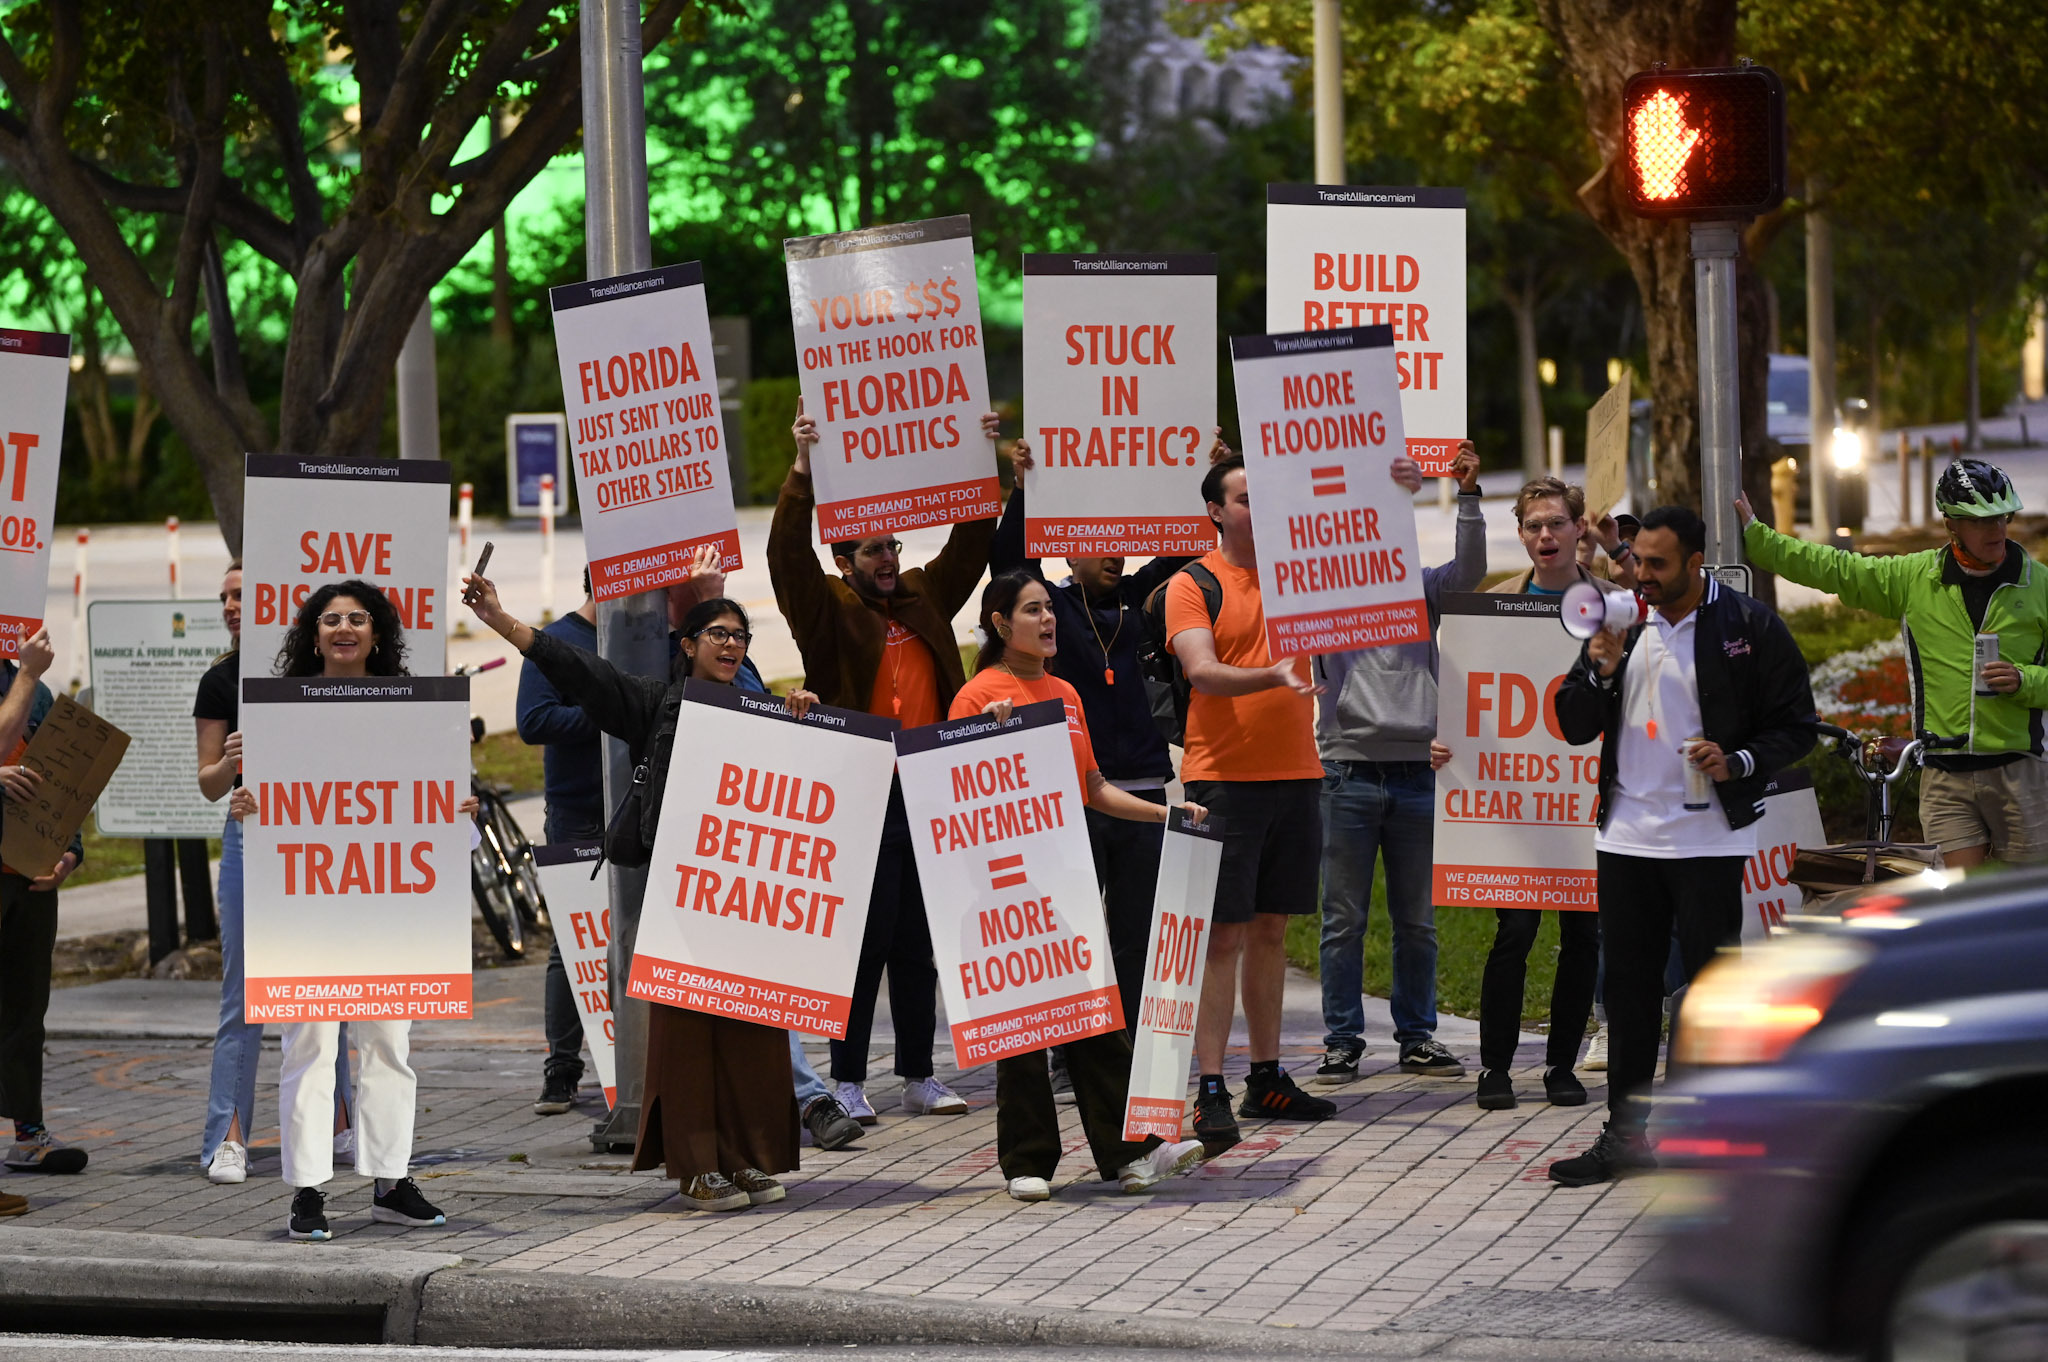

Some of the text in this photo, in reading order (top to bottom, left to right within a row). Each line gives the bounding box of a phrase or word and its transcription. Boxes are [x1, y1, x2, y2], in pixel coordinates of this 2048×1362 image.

[1314, 252, 1420, 293] BUILD
[809, 276, 961, 333] YOUR $$$
[1304, 300, 1430, 342] BETTER
[803, 324, 978, 370] ON THE HOOK FOR
[1065, 324, 1176, 365] STUCK
[579, 342, 701, 405] FLORIDA
[823, 362, 971, 423] FLORIDA
[1102, 376, 1138, 416] IN
[1282, 370, 1355, 411] MORE
[578, 392, 714, 445] JUST SENT YOUR
[842, 414, 961, 464] POLITICS
[1260, 411, 1386, 458] FLOODING
[579, 425, 719, 478] TAX DOLLARS TO
[1039, 425, 1201, 468] TRAFFIC?
[1411, 445, 1448, 456] FDOT
[597, 460, 712, 508] OTHER STATES
[834, 486, 983, 520] WE DEMAND THAT FDOT
[0, 516, 44, 550] OB.
[823, 501, 999, 540] INVEST IN FLORIDA'S FUTURE
[1043, 523, 1200, 537] WE DEMAND THAT FDOT
[1288, 508, 1381, 550] HIGHER
[300, 530, 393, 576] SAVE
[603, 564, 622, 577] WE
[622, 553, 668, 574] DEMAND
[668, 547, 695, 562] THAT
[1029, 539, 1214, 553] INVEST IN FLORIDA'S FUTURE
[596, 581, 631, 598] INVEST
[633, 578, 645, 588] IN
[1274, 547, 1407, 596] PREMIUMS
[254, 583, 435, 631] BISNE
[1276, 607, 1418, 635] WE DEMAND THAT FDOT TRACK
[178, 647, 203, 658] PARK
[1280, 622, 1419, 653] ITS CARBON POLLUTION
[950, 752, 1030, 804] MORE
[1478, 752, 1601, 785] NEEDS TO
[259, 780, 455, 826] INVEST IN
[716, 762, 836, 825] BUILD
[1444, 789, 1523, 820] CLEAR
[1532, 792, 1580, 822] THE
[930, 791, 1064, 855] PAVEMENT
[277, 841, 437, 896] TRAILS
[695, 813, 837, 883] BETTER
[1743, 843, 1797, 894] TUC
[675, 863, 845, 938] TRANSIT
[1445, 872, 1465, 883] WE
[1467, 873, 1520, 887] DEMAND
[1522, 875, 1553, 886] THAT
[1555, 876, 1586, 887] FDOT
[1446, 887, 1598, 905] ITS CARBON POLLUT
[978, 895, 1058, 948] MORE
[575, 958, 608, 985] JUS
[959, 935, 1093, 1000] FLOODING
[1152, 911, 1205, 987] FDOT
[250, 1000, 468, 1018] INVEST IN FLORIDA'S FUTURE
[266, 982, 451, 998] WE DEMAND THAT FDOT
[632, 980, 843, 1035] INVEST IN FLORIDA'S FUTURE
[652, 965, 830, 1013] WE DEMAND THAT FDOT
[962, 995, 1111, 1041] WE DEMAND THAT FDOT TRACK
[967, 1012, 1113, 1060] ITS CARBON POLLUTION
[1141, 996, 1194, 1032] DO YOUR JOB.
